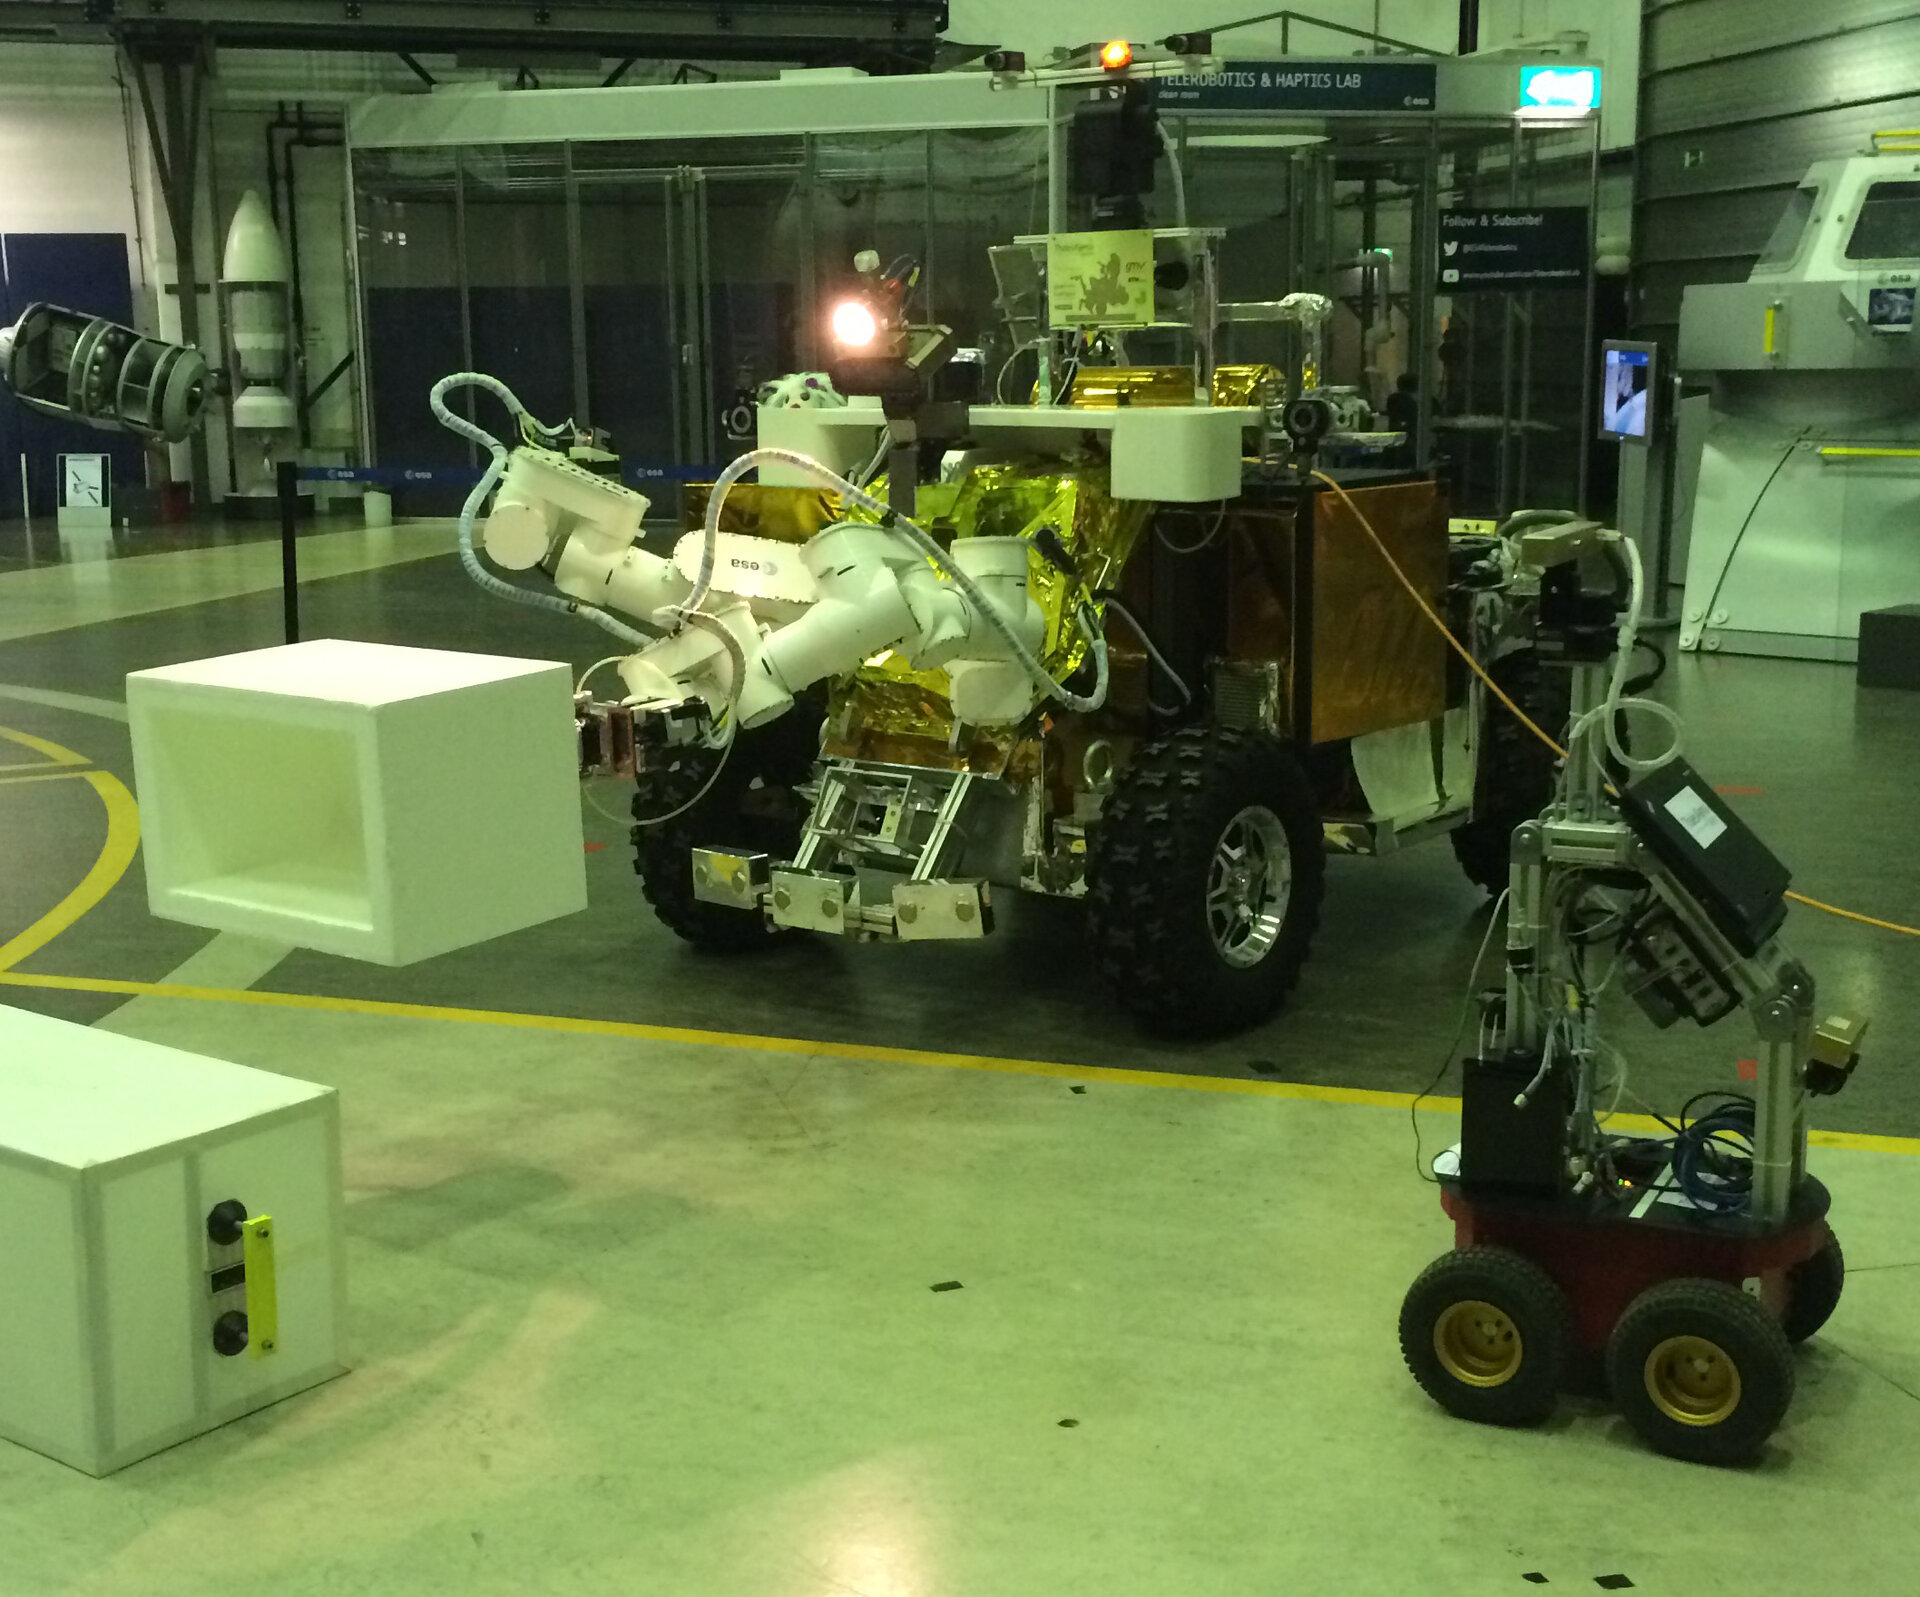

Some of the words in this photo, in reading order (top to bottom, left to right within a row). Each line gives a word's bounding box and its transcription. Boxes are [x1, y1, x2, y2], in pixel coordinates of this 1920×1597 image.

[1261, 72, 1271, 88] &
[1276, 73, 1331, 88] HAPTICS
[1336, 73, 1361, 88] LAB
[1443, 215, 1477, 227] Follow
[1480, 214, 1489, 226] &
[731, 558, 759, 571] esa
